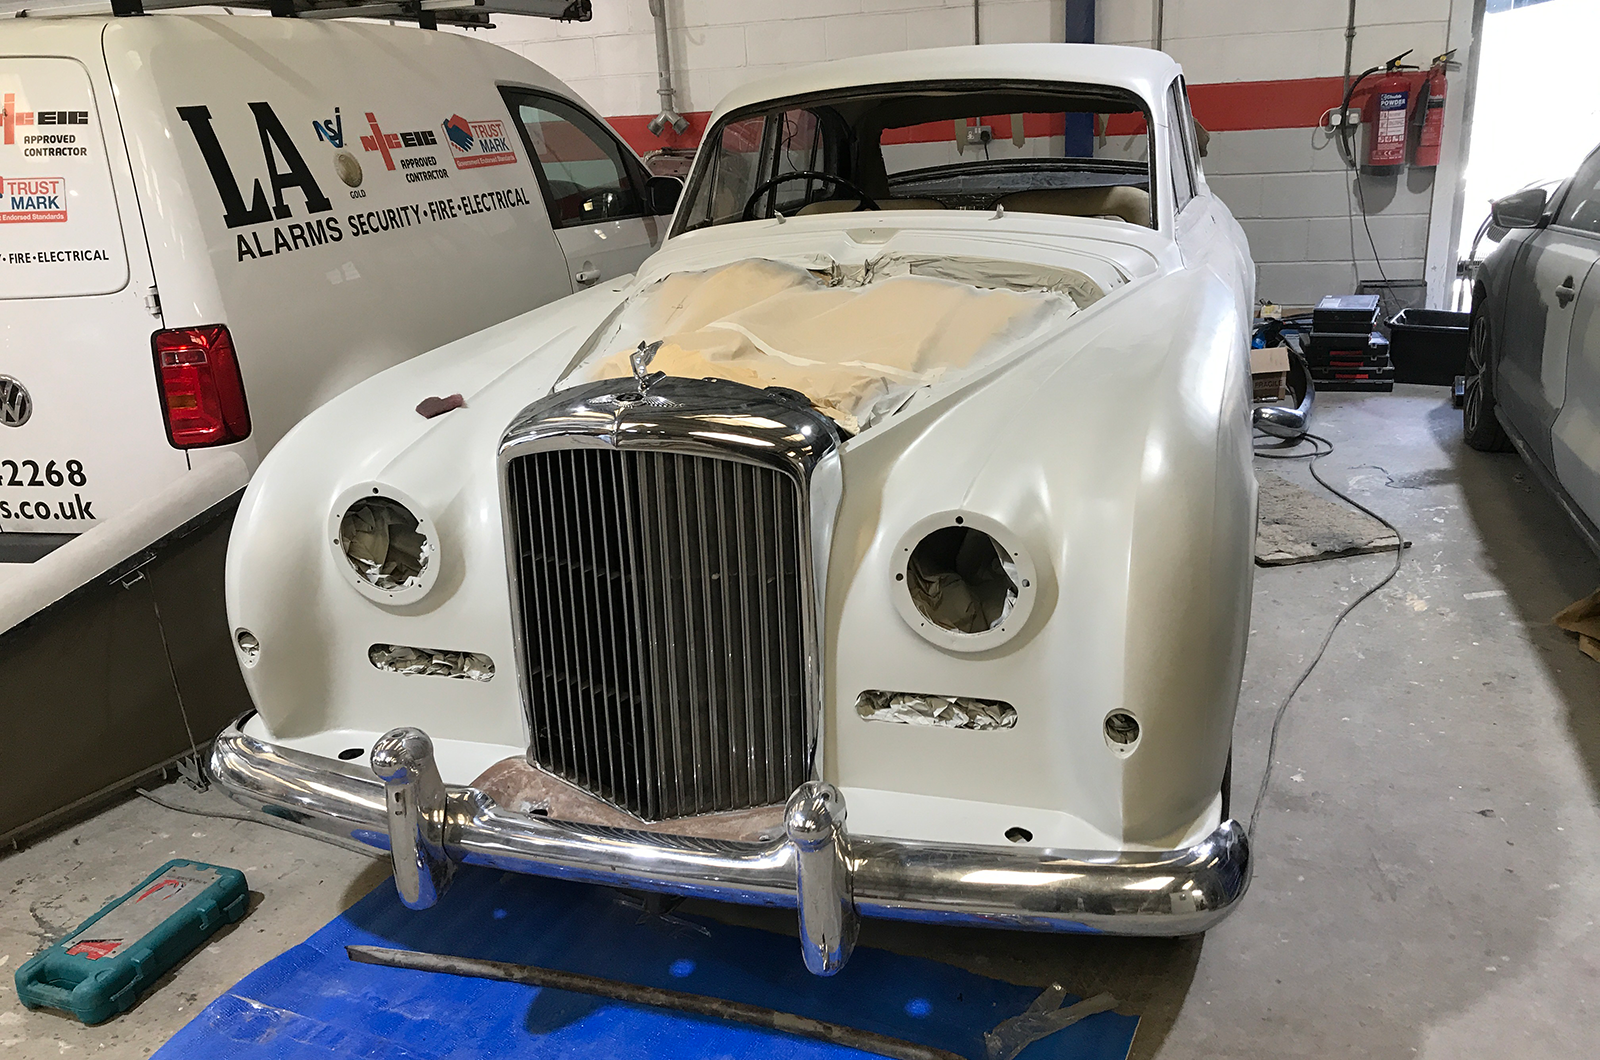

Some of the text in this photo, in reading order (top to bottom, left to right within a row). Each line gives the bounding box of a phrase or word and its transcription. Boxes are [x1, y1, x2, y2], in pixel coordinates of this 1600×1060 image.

[1381, 98, 1406, 106] POWDER
[471, 124, 504, 138] TRUST
[24, 134, 76, 144] APPROVED
[479, 138, 510, 153] MARK
[24, 147, 88, 157] CONTRACTOR
[175, 101, 333, 229] LA
[400, 156, 437, 169] APPROVED
[456, 158, 480, 167] Government
[406, 169, 449, 183] CONTRACTOR
[7, 181, 59, 195] TRUST
[349, 189, 366, 199] GOLD
[11, 196, 60, 210] MARK
[2, 213, 31, 221] Endorsed
[32, 212, 65, 220] Standards
[236, 216, 343, 262] ALARMS
[347, 204, 421, 237] SECURITY
[460, 187, 530, 216] ELECTRICAL
[37, 249, 109, 263] ELECTRICAL
[1254, 380, 1283, 388] FRAGILE
[0, 493, 97, 520] s.co.uk
